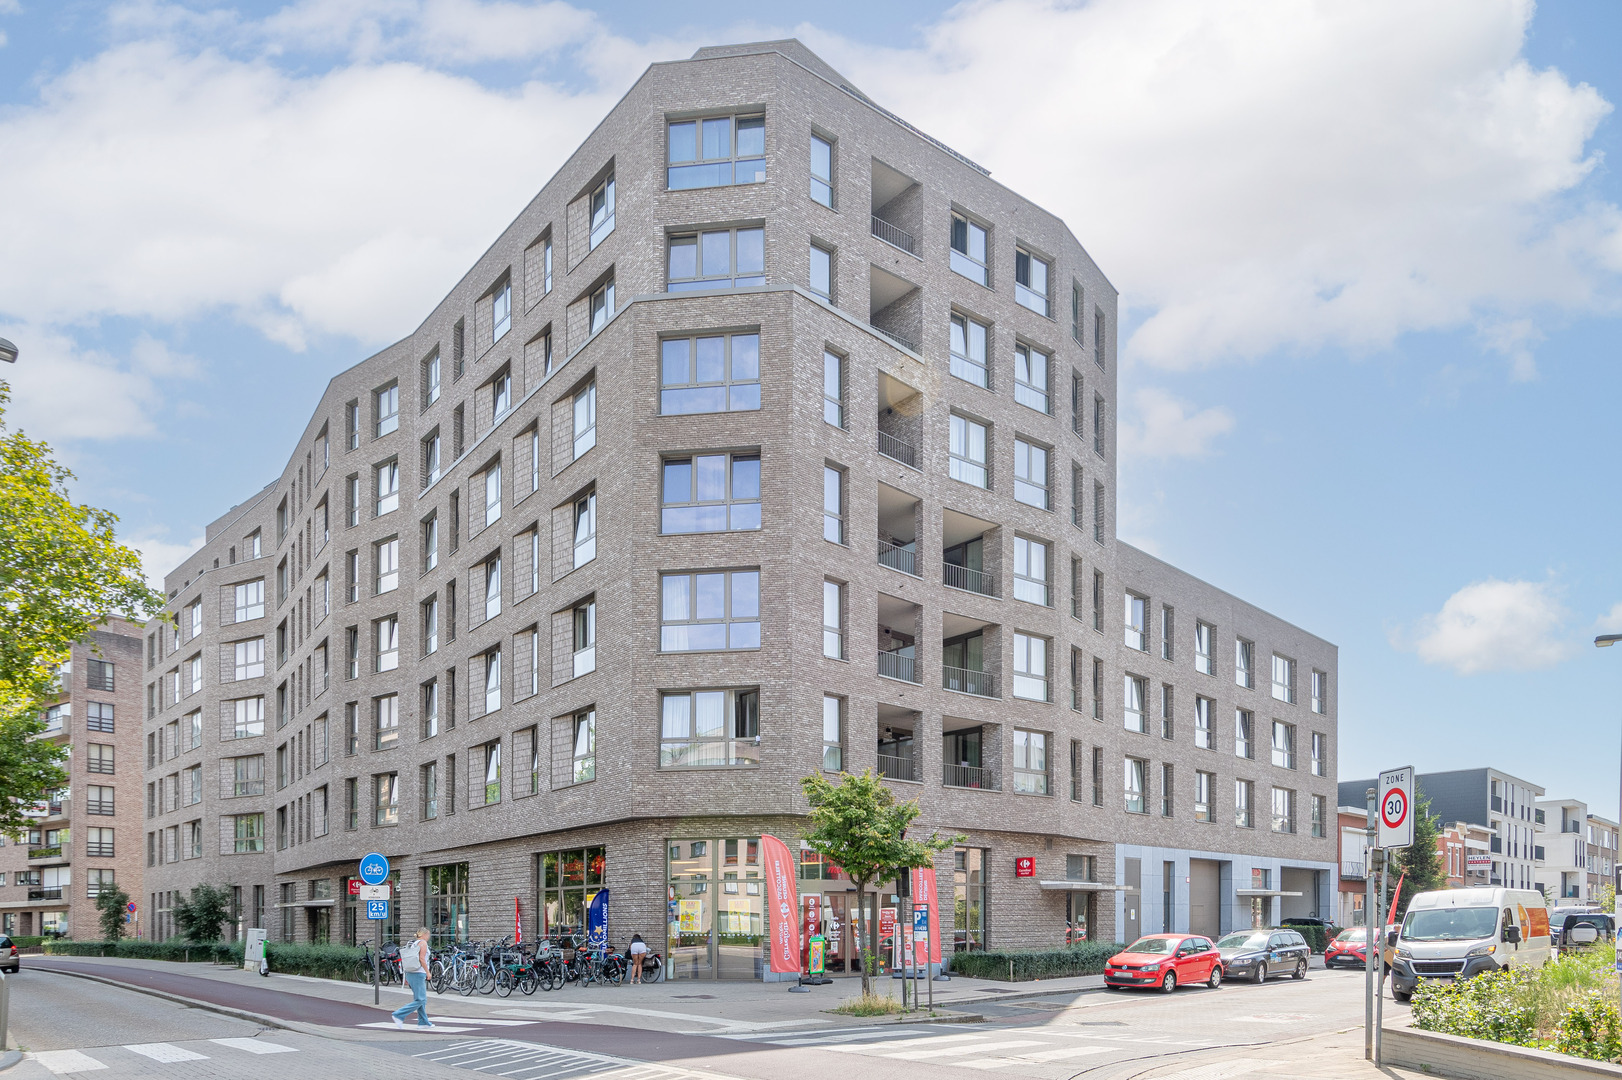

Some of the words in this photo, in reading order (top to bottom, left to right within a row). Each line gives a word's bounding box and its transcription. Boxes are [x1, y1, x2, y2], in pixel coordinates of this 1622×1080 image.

[1386, 774, 1404, 784] ZONE
[1388, 800, 1401, 815] 30
[371, 903, 384, 911] 25
[914, 911, 922, 924] P
